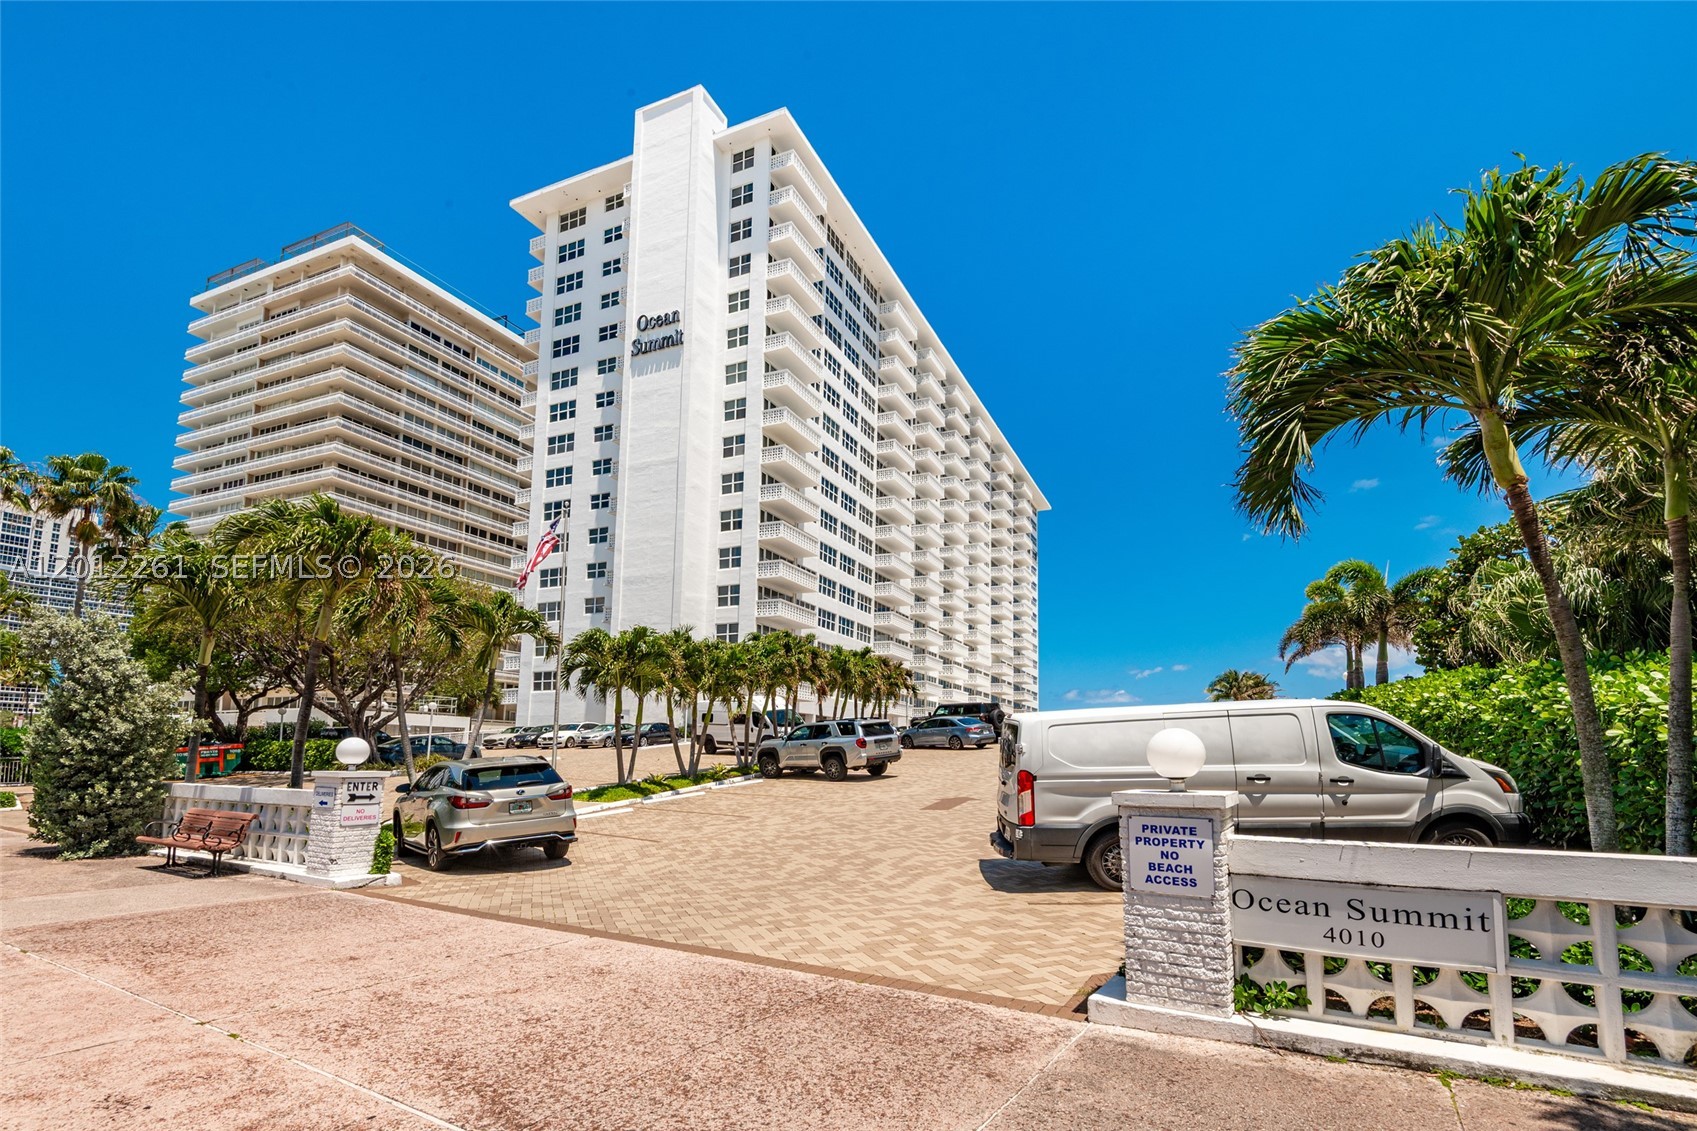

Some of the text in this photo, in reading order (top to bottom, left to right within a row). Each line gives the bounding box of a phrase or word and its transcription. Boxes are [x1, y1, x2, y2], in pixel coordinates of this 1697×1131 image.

[637, 310, 680, 332] Ocean
[631, 329, 684, 356] Summit
[347, 782, 378, 791] ENTER
[1141, 824, 1198, 836] PRIVATE
[1135, 836, 1205, 849] PROPERTY
[1160, 850, 1180, 860] NO
[1148, 862, 1193, 874] BEACH
[1145, 874, 1198, 888] ACCESS
[1232, 888, 1491, 933] Ocean Summit
[1322, 926, 1385, 949] 4010
